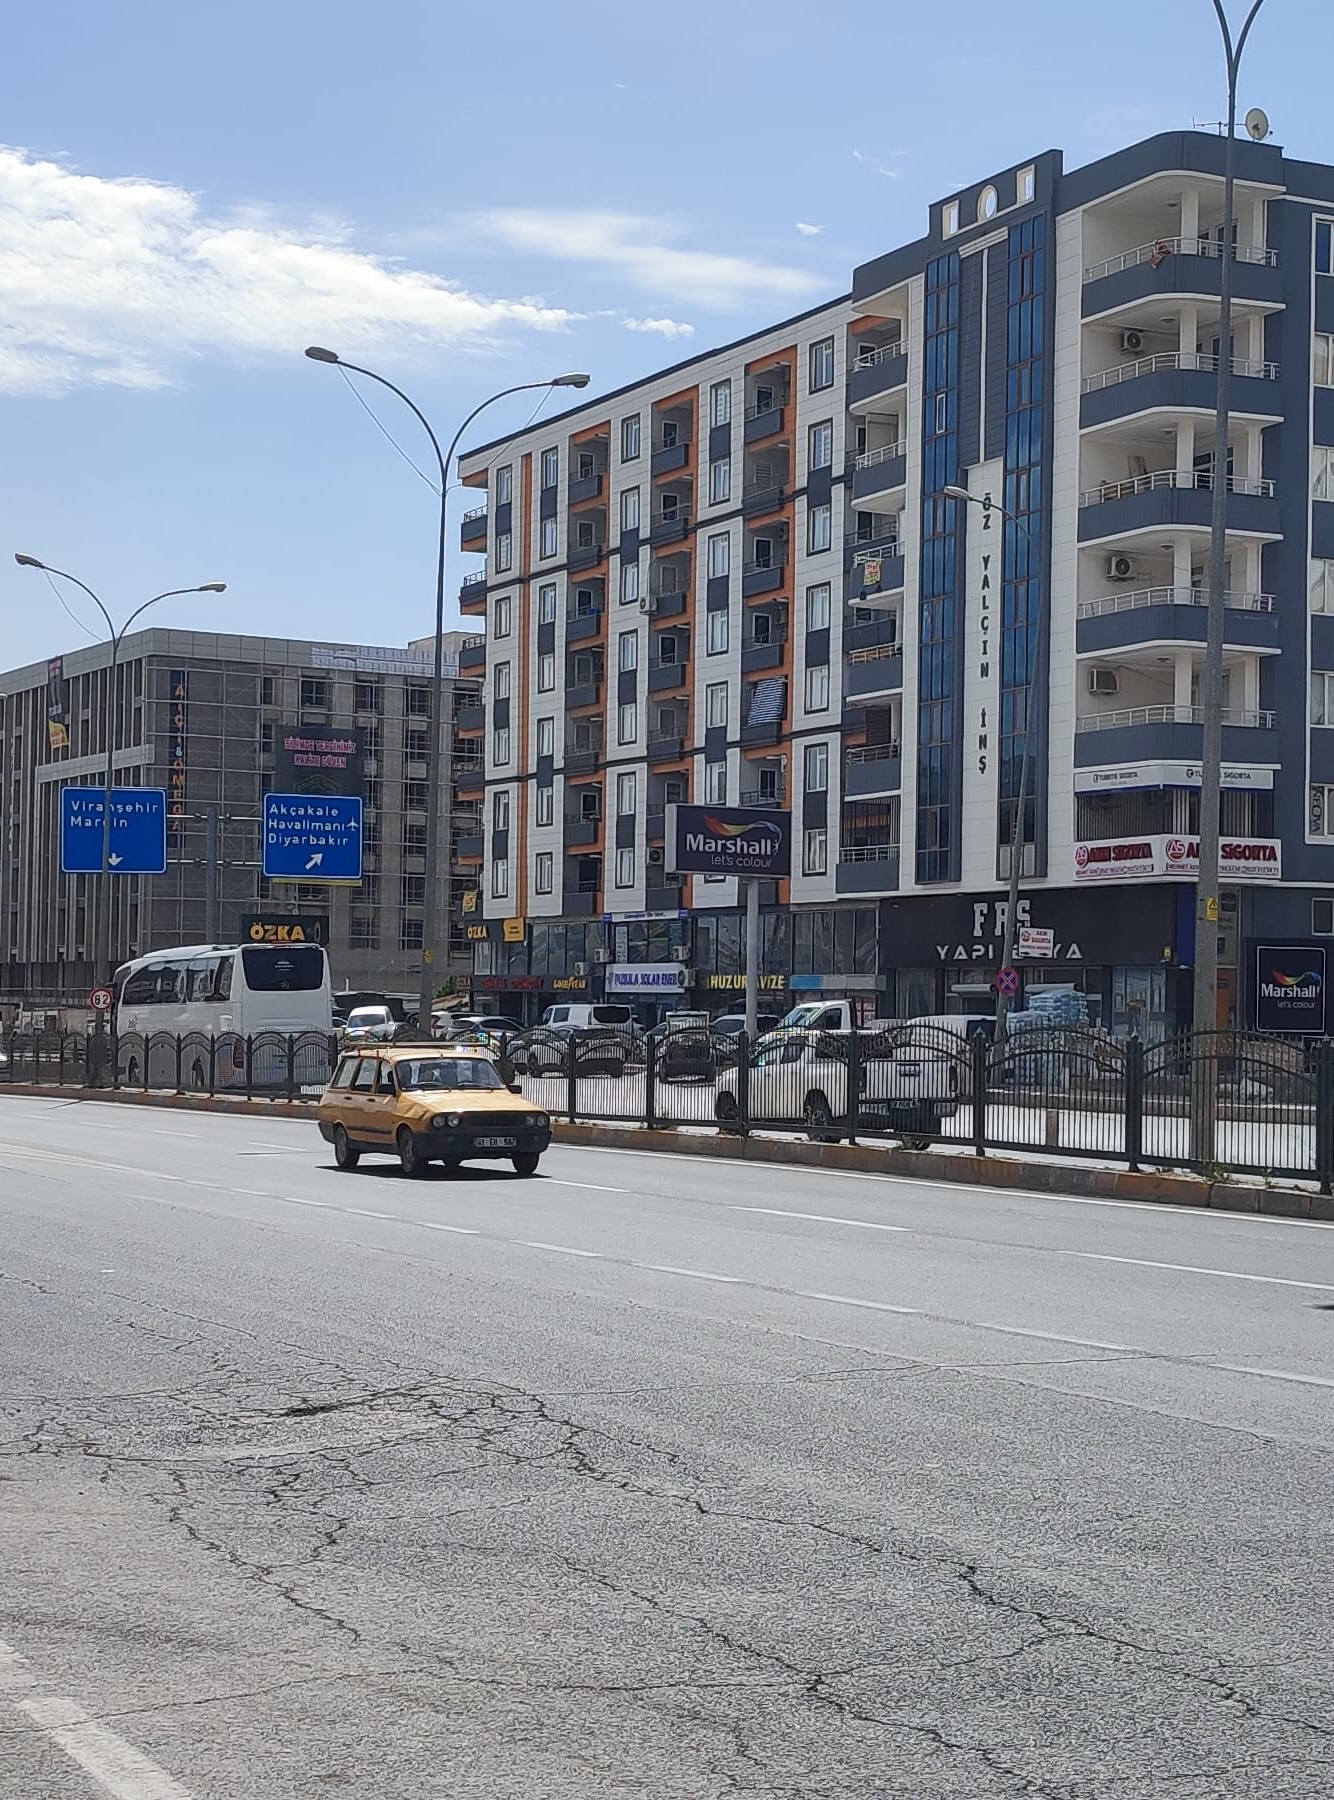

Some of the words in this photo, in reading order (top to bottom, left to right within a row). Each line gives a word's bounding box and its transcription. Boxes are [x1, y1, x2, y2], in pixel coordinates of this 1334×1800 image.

[980, 554, 991, 679] YALÇIN
[977, 707, 989, 774] İNŞ
[269, 803, 339, 817] Akçakale
[70, 815, 128, 828] Marin
[268, 832, 348, 847] Diyarbakır
[687, 833, 771, 855] Marshall
[711, 855, 733, 866] let's
[736, 857, 771, 868] colour
[250, 921, 306, 941] ÖZKA
[936, 944, 995, 960] YAPI
[1011, 943, 1084, 960] BYA
[756, 975, 784, 990] VİZE
[1261, 983, 1316, 998] Marshall
[94, 994, 108, 1005] 82
